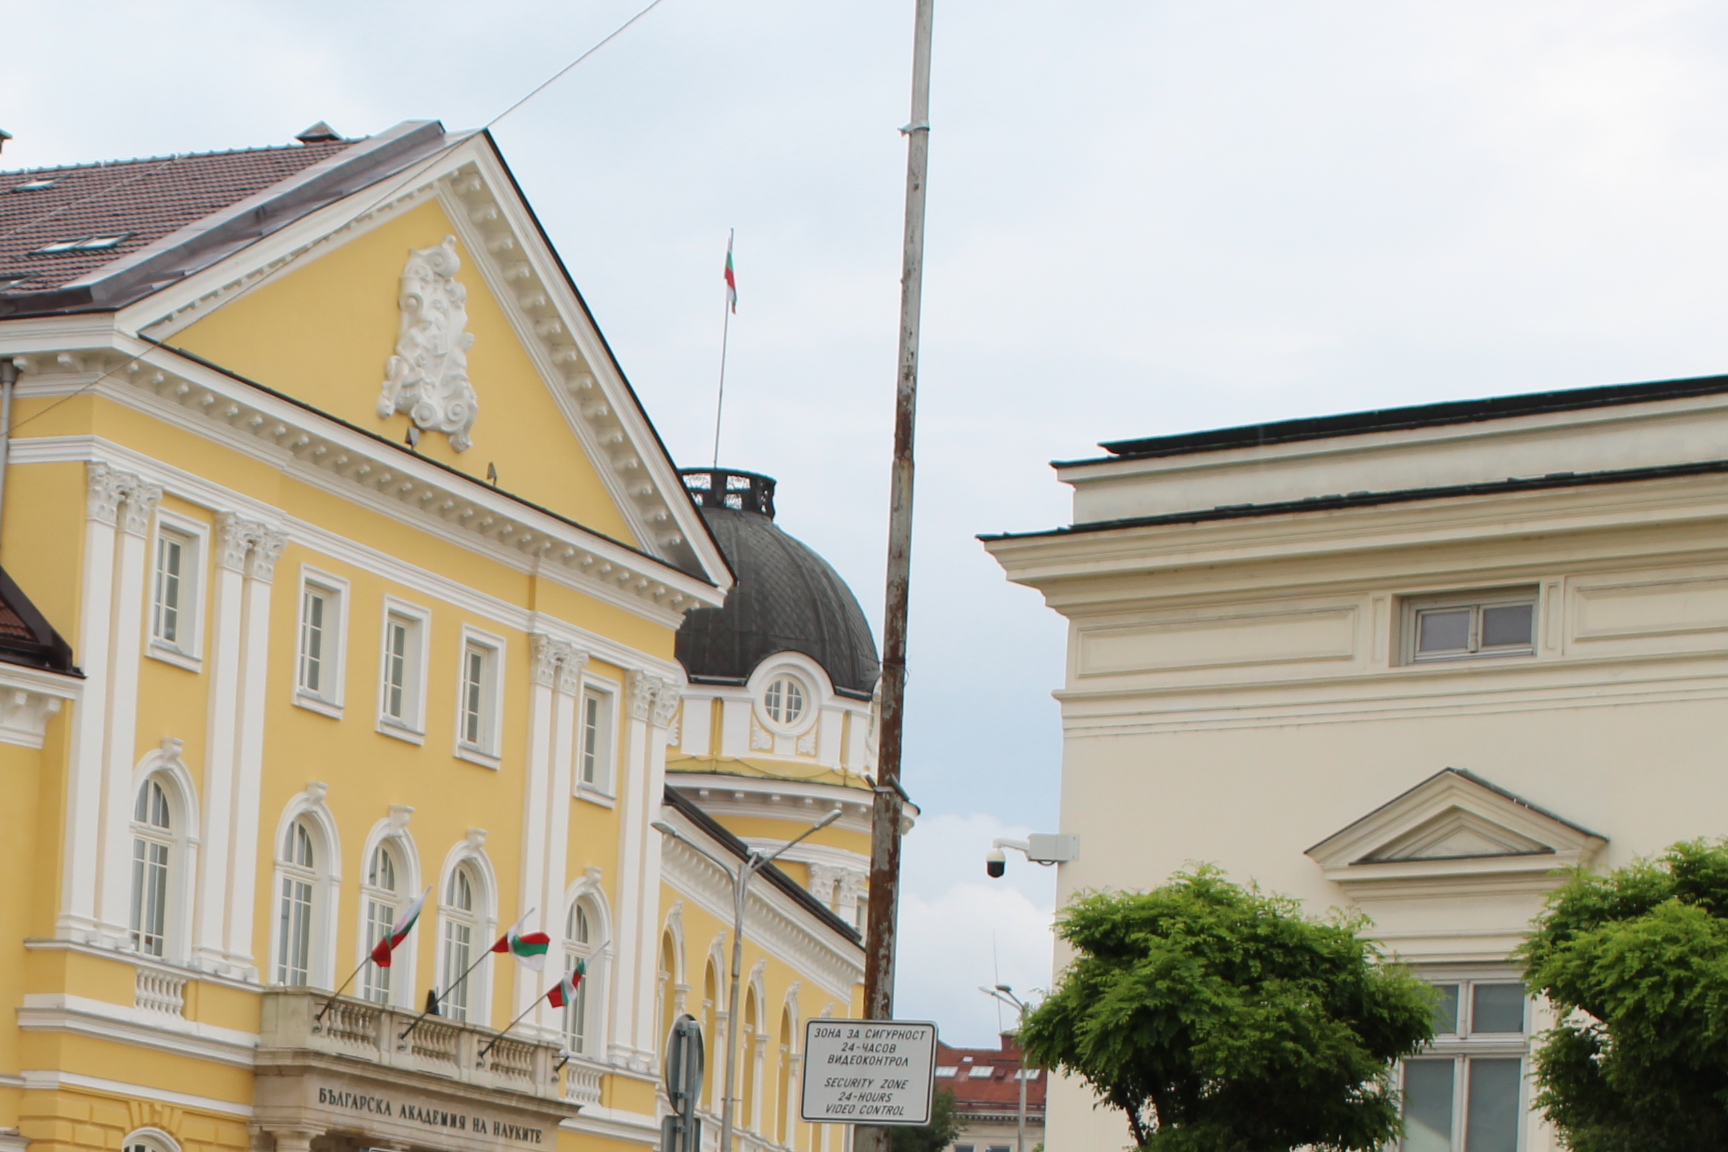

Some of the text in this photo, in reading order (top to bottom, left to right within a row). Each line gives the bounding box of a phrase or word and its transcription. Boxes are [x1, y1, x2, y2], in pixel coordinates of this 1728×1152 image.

[814, 1028, 926, 1041] ЗОНА ЗА СИГУРНОСТ
[841, 1042, 897, 1054] 24-ЧАСОВ
[827, 1054, 909, 1066] ВИДЕОКОНТРОЛ
[824, 1077, 909, 1089] SECURITY ZONE
[838, 1091, 893, 1103] 24-HOURS
[319, 1087, 542, 1144] БЪЛГАРСКА АКАДЕМИЯ НА НАУКИТЕ
[826, 1104, 904, 1115] VIDEO CONTROL
